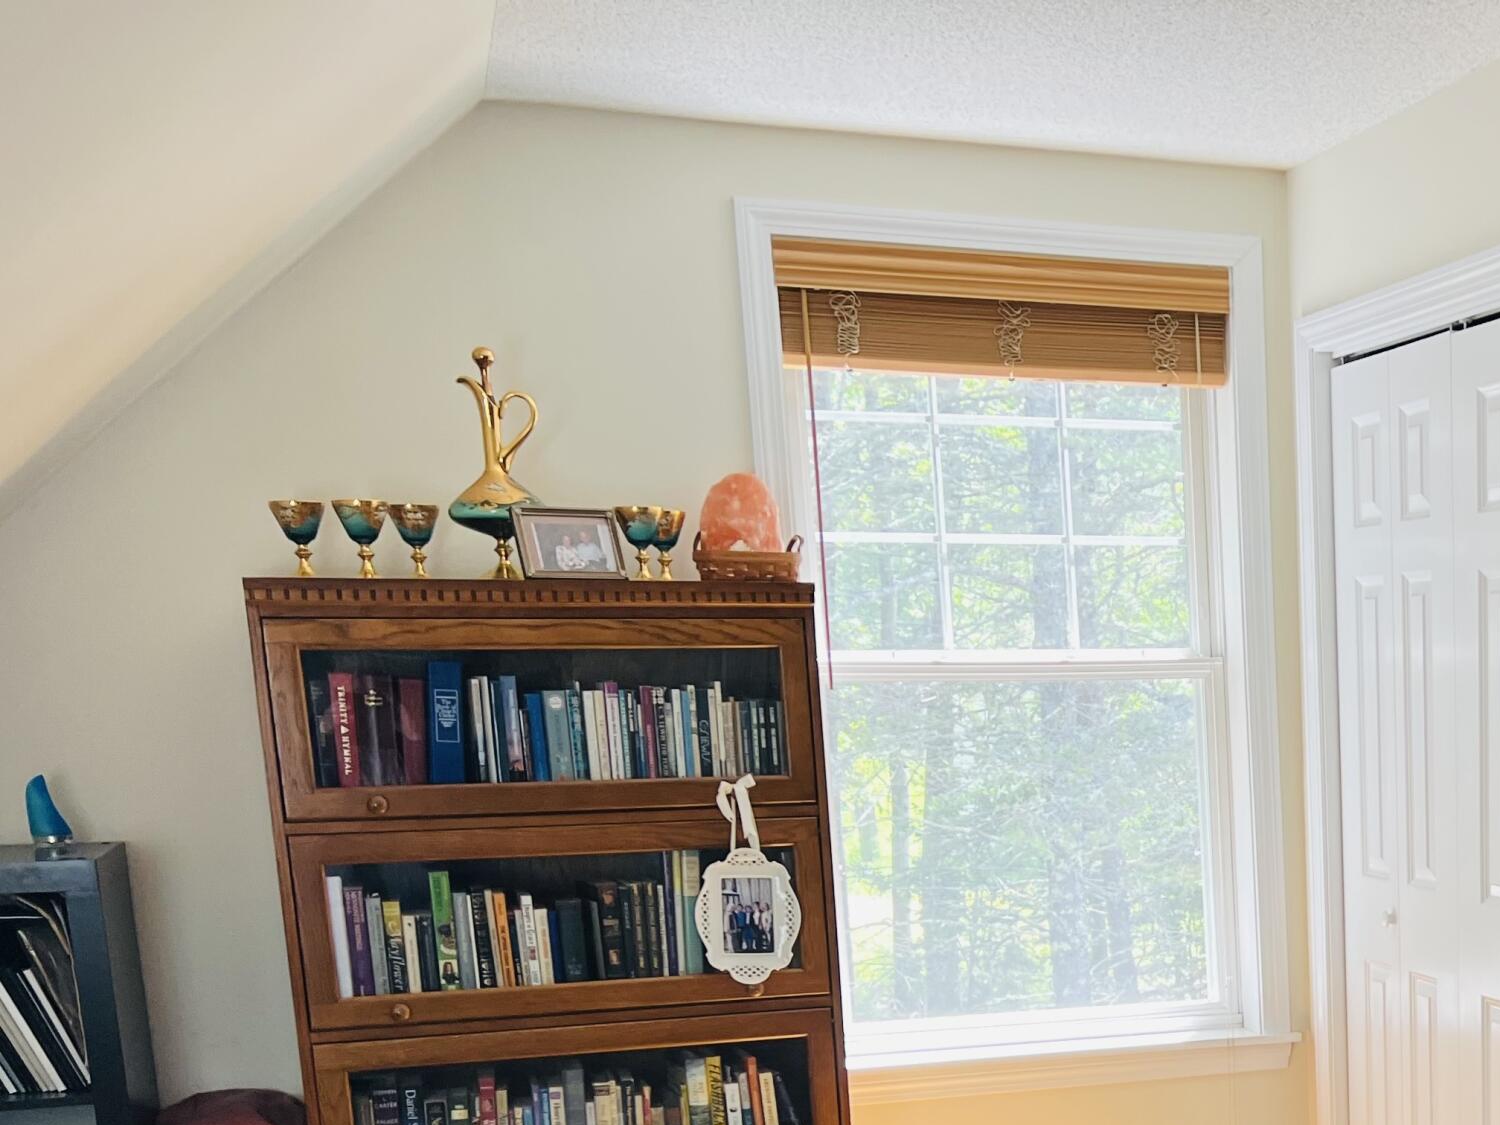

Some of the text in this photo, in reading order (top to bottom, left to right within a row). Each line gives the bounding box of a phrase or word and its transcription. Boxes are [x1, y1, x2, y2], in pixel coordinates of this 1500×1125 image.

[336, 685, 354, 776] TRINITY HYMNAL
[387, 920, 406, 991] Mayflower
[404, 1088, 419, 1120] Daniel
